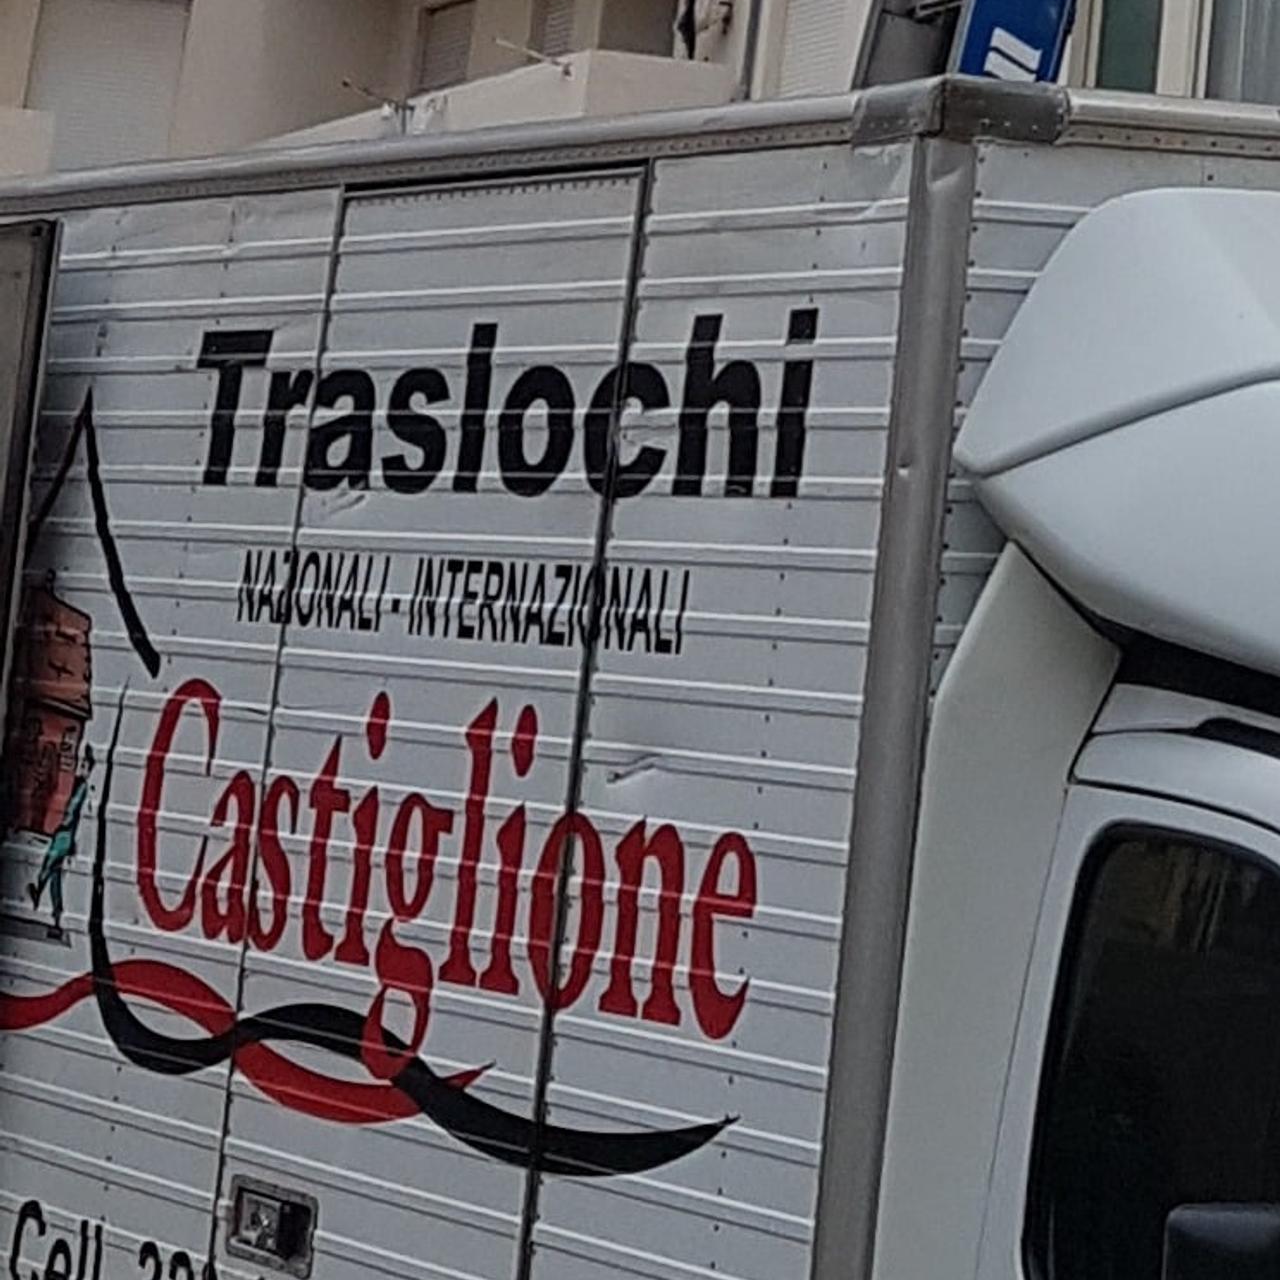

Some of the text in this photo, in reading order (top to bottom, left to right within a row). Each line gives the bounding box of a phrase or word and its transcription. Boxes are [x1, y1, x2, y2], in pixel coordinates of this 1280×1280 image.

[198, 308, 820, 498] Traslochi
[408, 556, 690, 655] INTERNAZIONALI
[136, 677, 758, 1079] Castiglione
